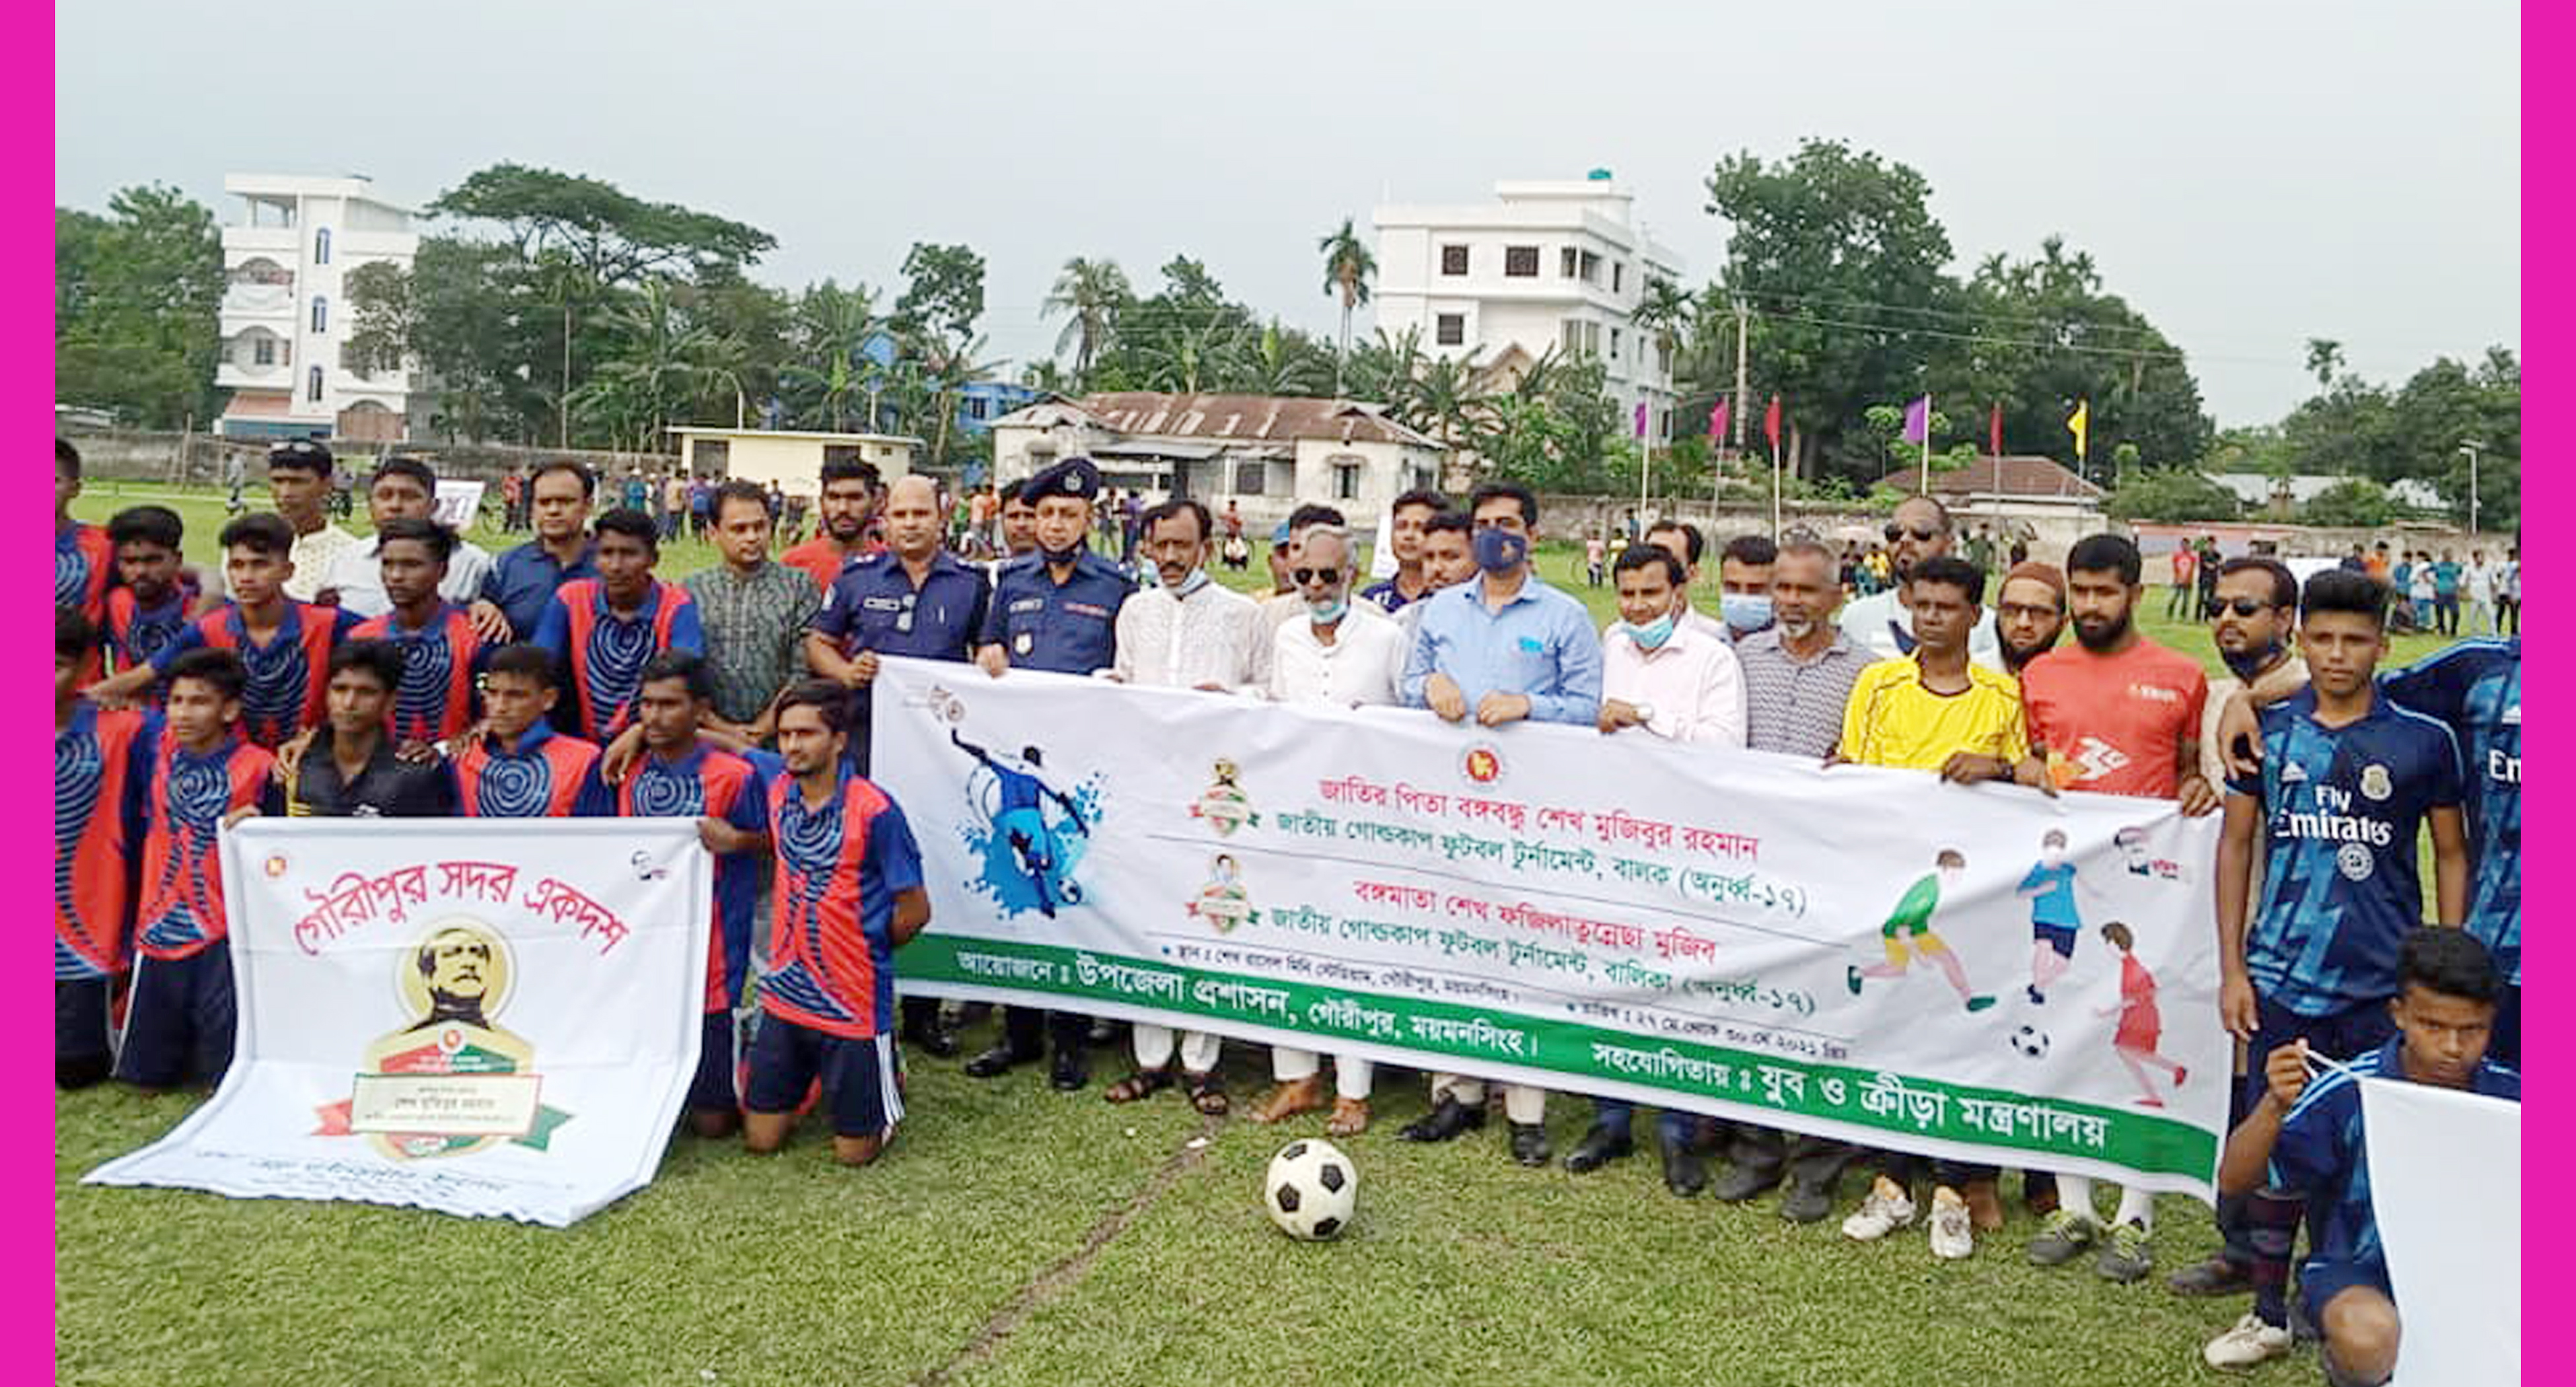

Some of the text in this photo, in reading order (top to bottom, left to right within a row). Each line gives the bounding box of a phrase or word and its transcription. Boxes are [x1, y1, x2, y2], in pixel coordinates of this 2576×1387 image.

[1319, 775, 1759, 860] জাতির পিতা বঙ্গবন্ধু শেখ মুজিবুর রহমান
[2315, 784, 2351, 812] Fly
[1277, 808, 1337, 837] জাতীয়
[1346, 821, 1433, 851] গোল্ডকাপ
[1442, 830, 1505, 861] ফুটবল
[1613, 857, 1672, 886] বালক
[293, 864, 428, 956] গৌরীপুর
[437, 860, 519, 904] সদর
[1271, 905, 1332, 935] জাতীয়
[1340, 918, 1429, 946] গোল্ডকাপ
[1439, 928, 1500, 958] ফুটবল
[1604, 959, 1672, 992] বালিকা
[1353, 880, 1437, 911] বঙ্গমাতা
[1446, 896, 1489, 923] শেখ
[1653, 926, 1717, 964] মুজিব
[956, 949, 1055, 982] আয়োজনে
[1075, 952, 1186, 1002] উপজেলা
[1591, 1042, 1731, 1089] সহযোগিতায়
[1756, 1064, 1808, 1106] যুব
[1818, 1075, 1847, 1106] ও
[1857, 1072, 1949, 1130] ক্রীড়া
[1956, 1094, 2111, 1149] মন্ত্রণালয়
